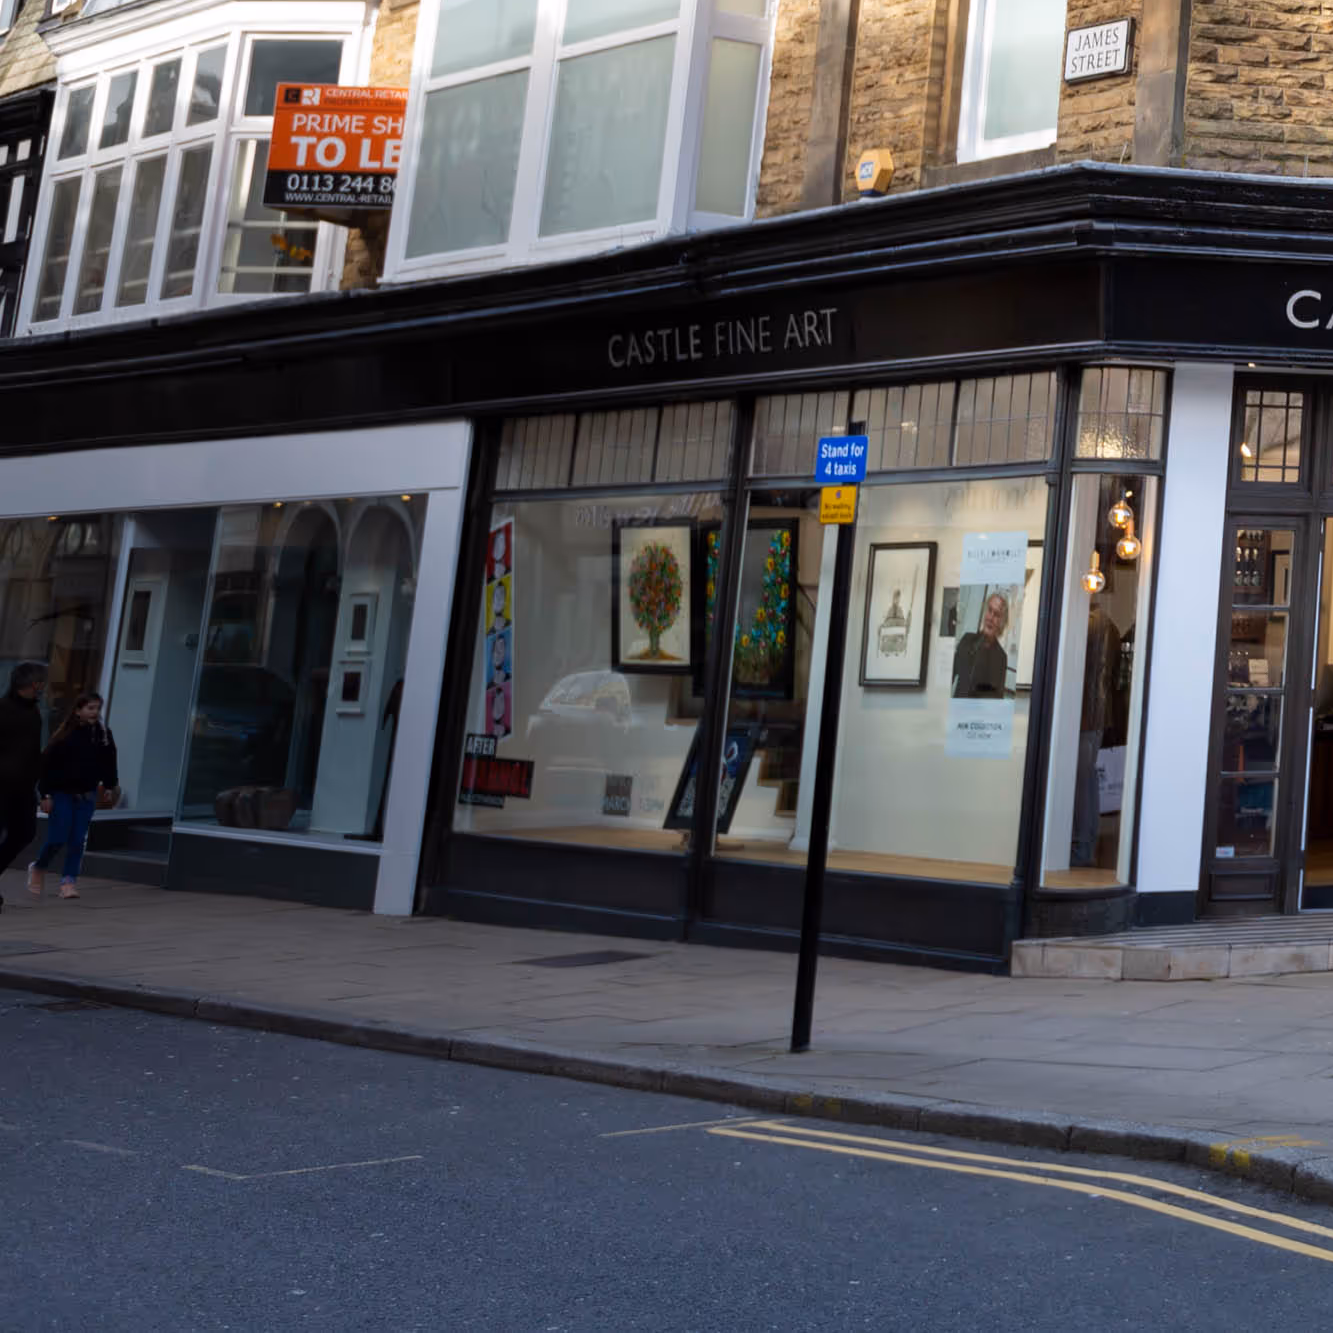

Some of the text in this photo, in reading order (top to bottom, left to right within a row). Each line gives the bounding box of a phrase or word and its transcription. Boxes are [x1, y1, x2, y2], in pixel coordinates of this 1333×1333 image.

[1075, 27, 1119, 52] JAMES
[1071, 49, 1120, 74] STREET
[326, 89, 371, 99] CENTRAL
[291, 113, 366, 134] PRIME
[290, 136, 346, 168] TO
[287, 173, 334, 192] 0113
[339, 175, 374, 193] 244
[608, 308, 837, 367] CASTLE FINE ART
[821, 442, 864, 458] Stand for
[824, 460, 857, 476] 4 taxis
[466, 736, 495, 755] AFTER
